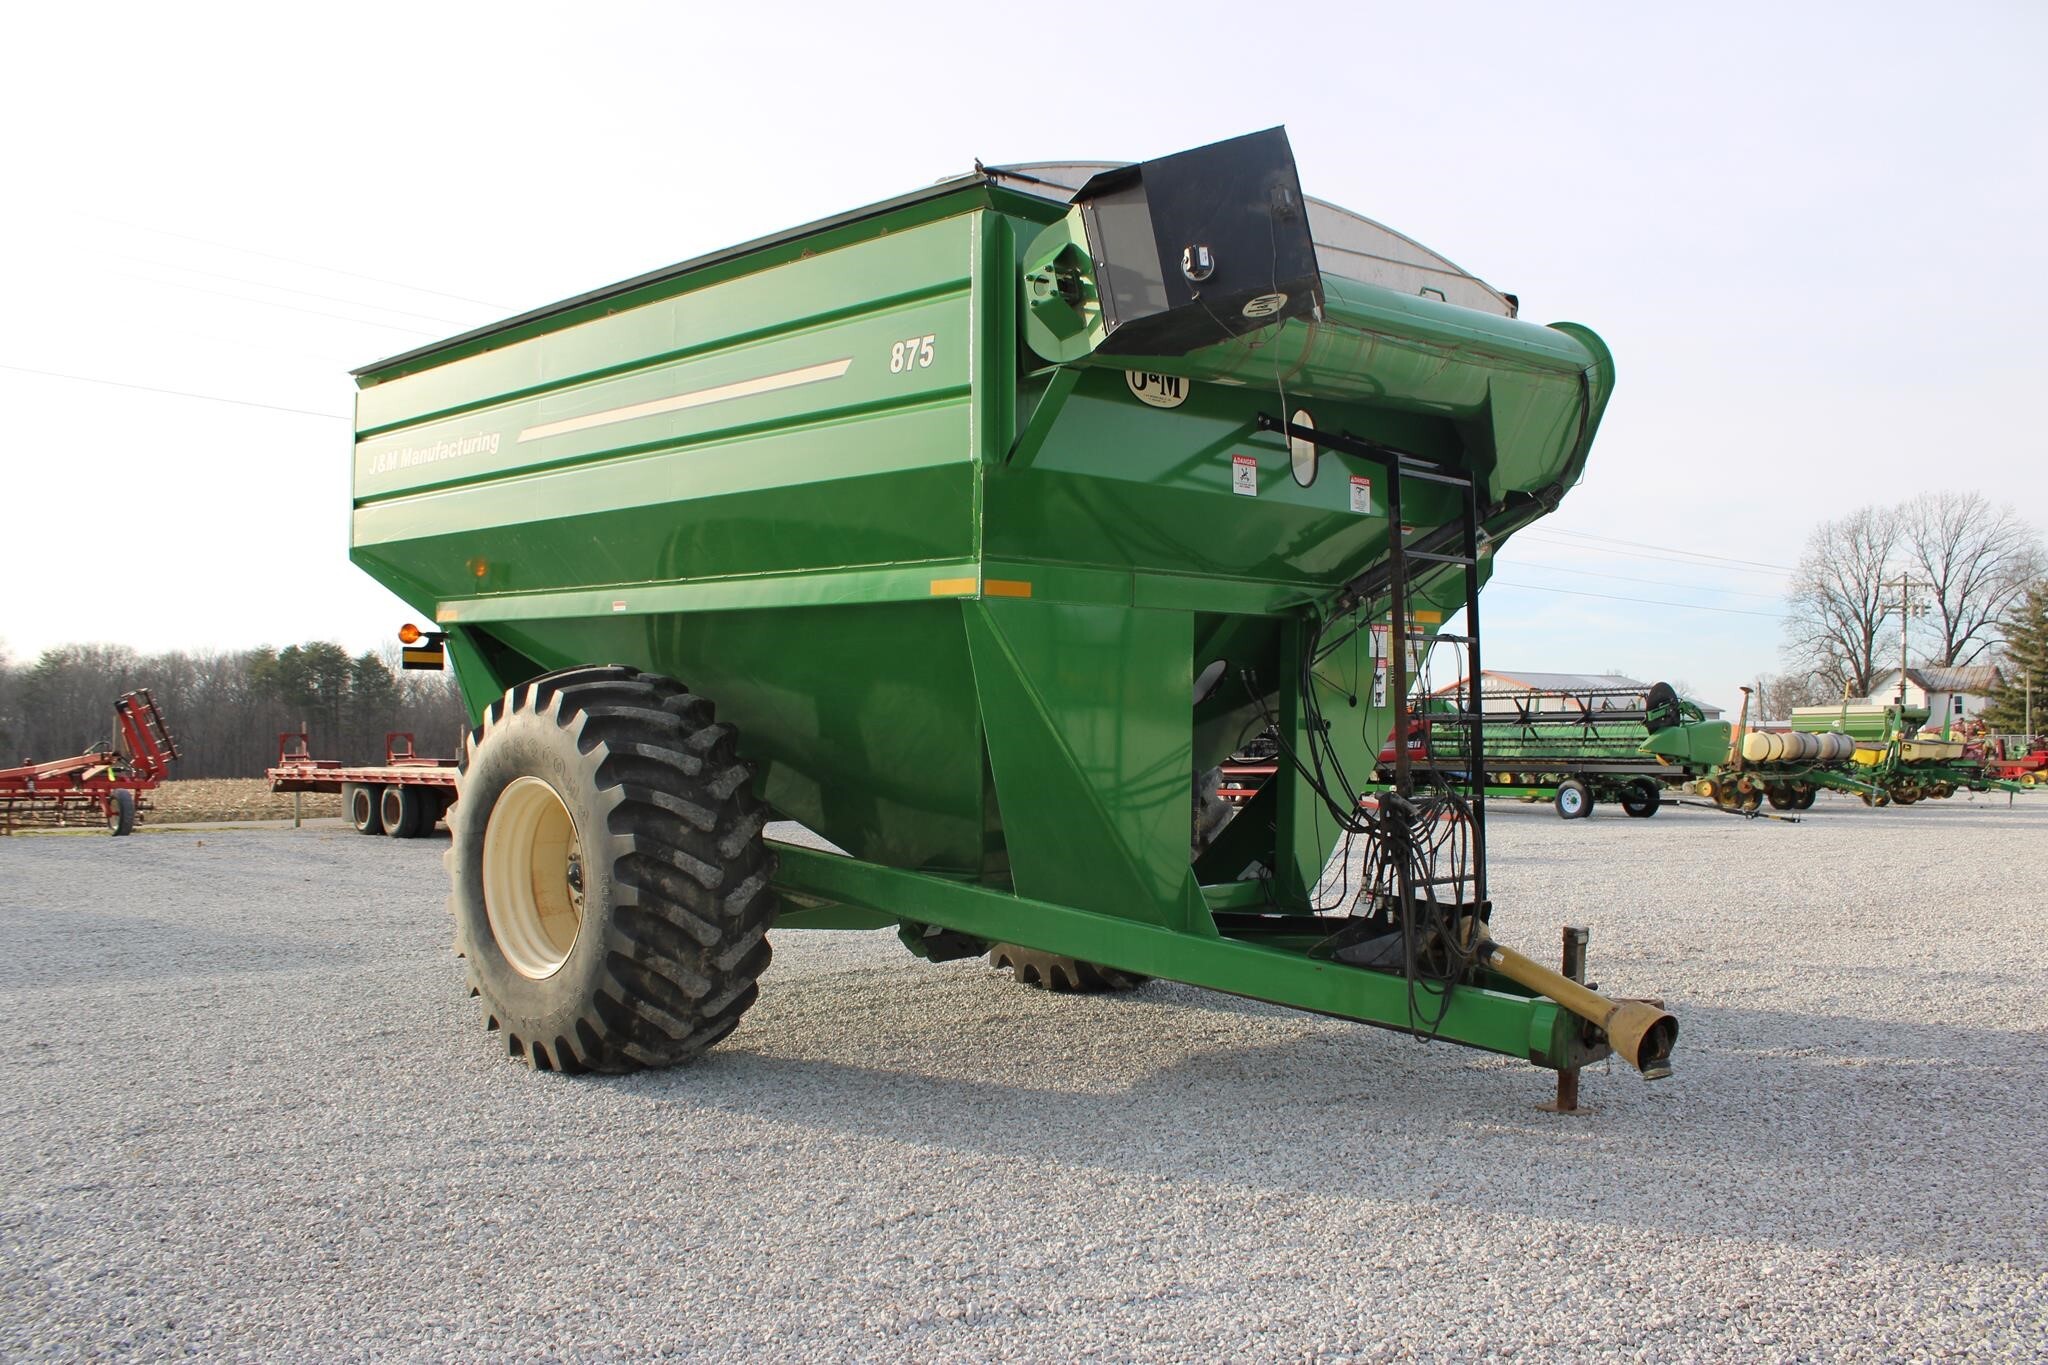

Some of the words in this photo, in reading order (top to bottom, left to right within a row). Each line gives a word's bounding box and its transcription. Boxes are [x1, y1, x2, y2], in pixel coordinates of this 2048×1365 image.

[890, 334, 936, 374] 875
[368, 450, 398, 475] J&M
[400, 431, 501, 469] Manufacturing
